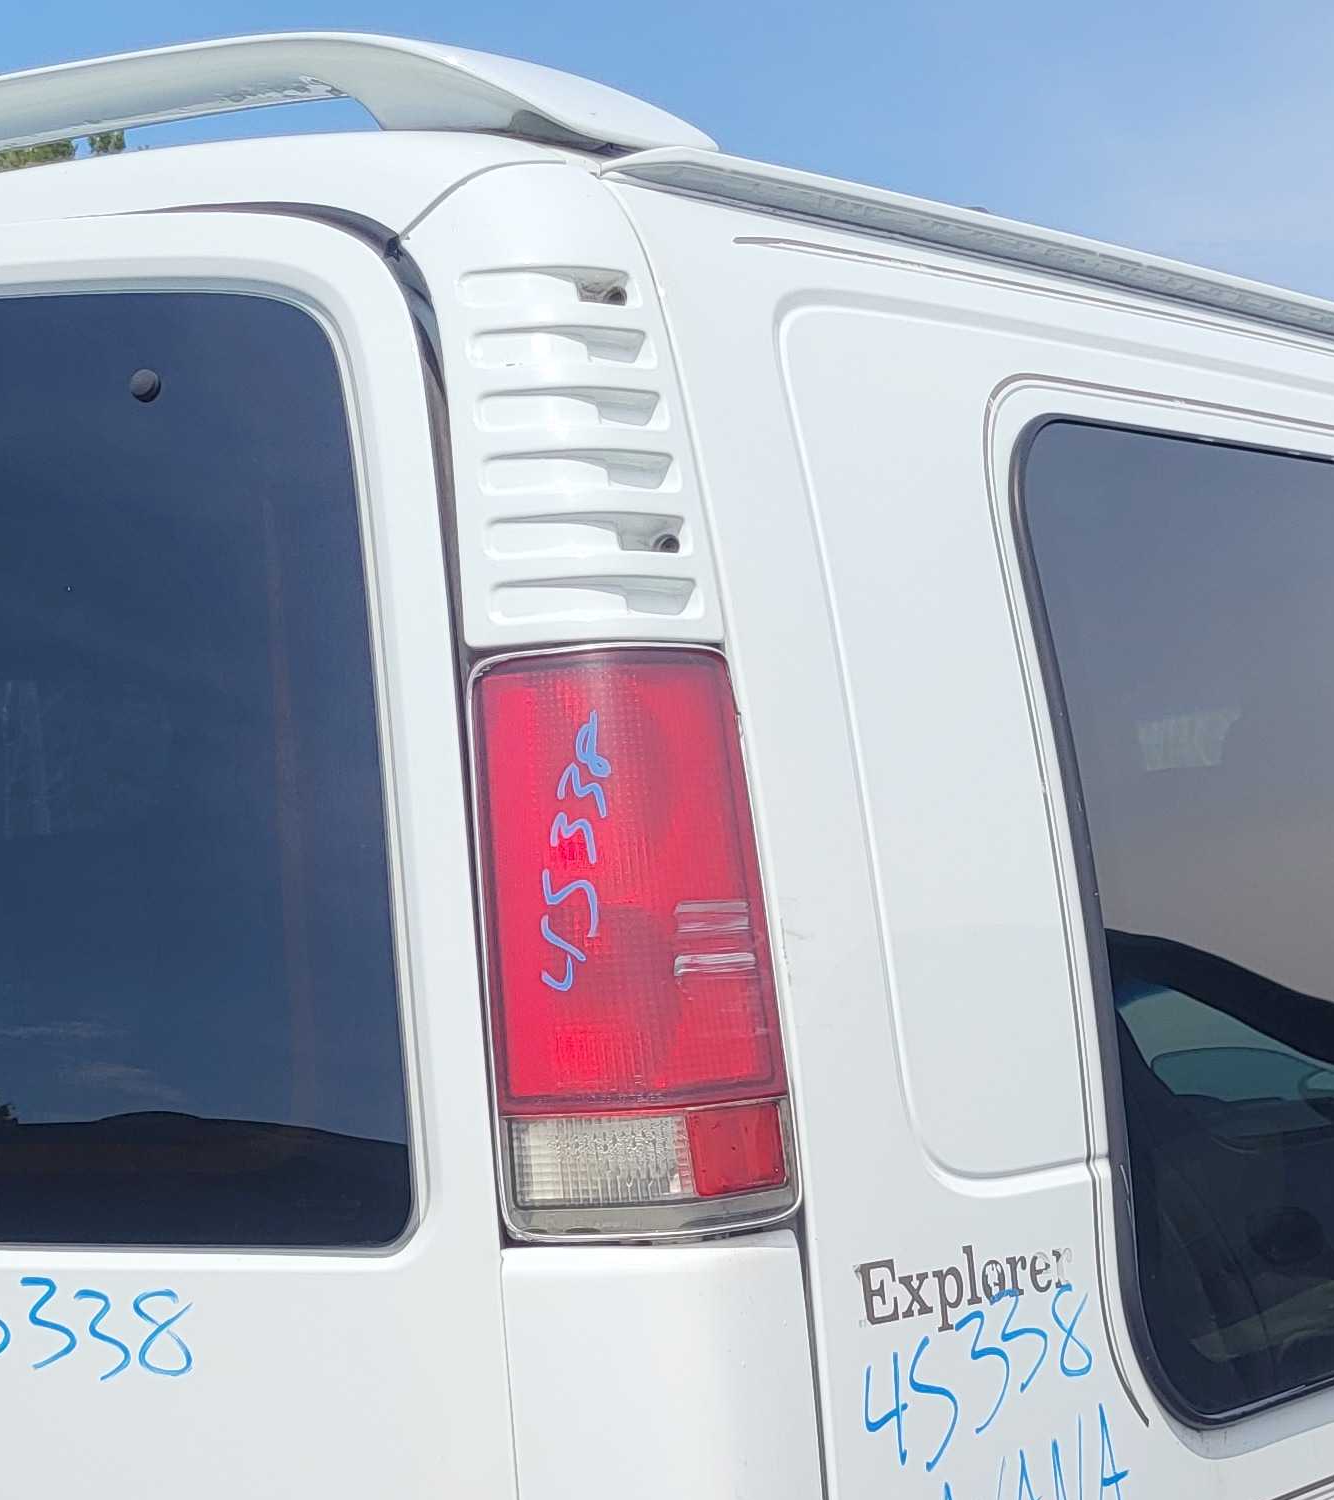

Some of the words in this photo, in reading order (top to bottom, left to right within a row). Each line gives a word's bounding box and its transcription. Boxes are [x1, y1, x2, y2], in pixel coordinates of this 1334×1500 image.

[541, 711, 611, 992] 45338
[853, 1245, 1072, 1332] Explorer
[865, 1283, 1093, 1472] 45338
